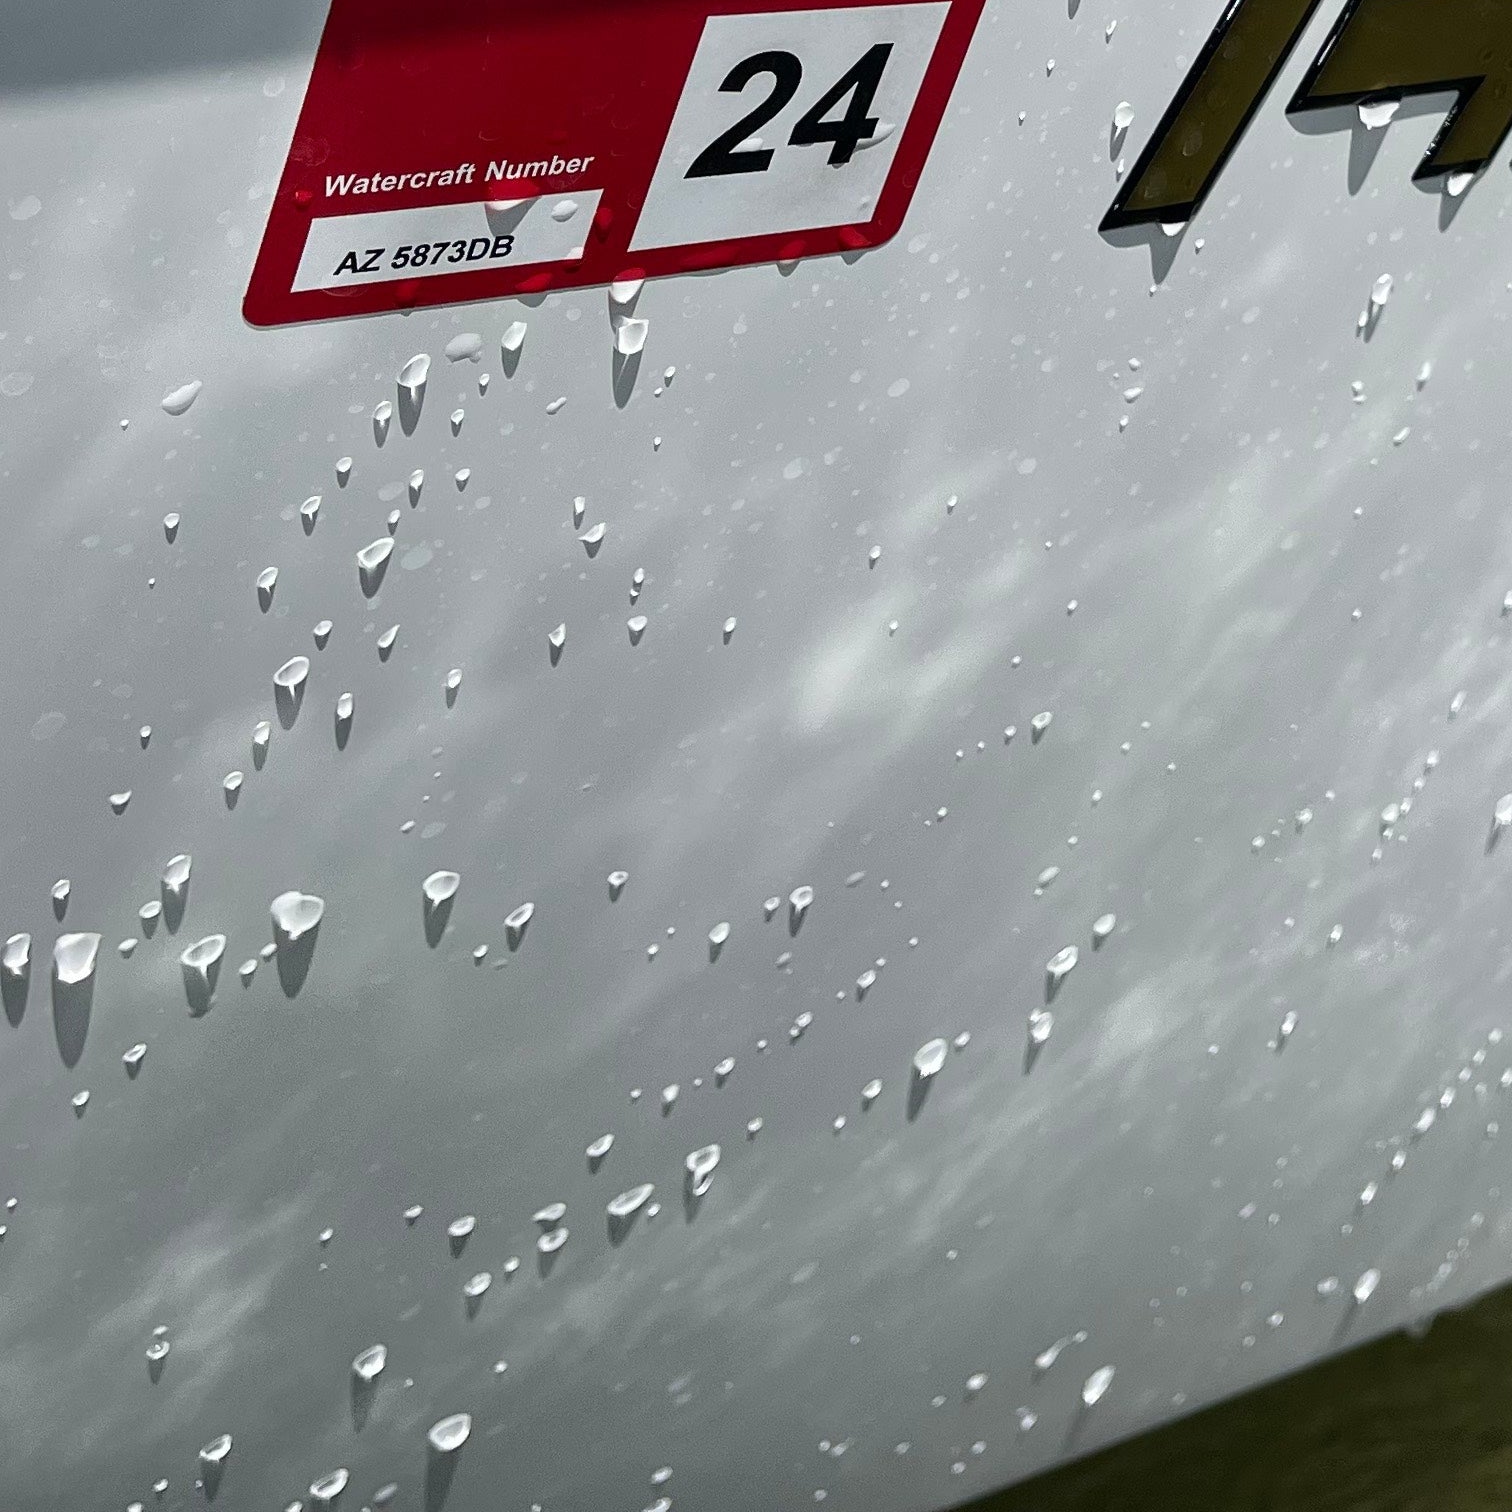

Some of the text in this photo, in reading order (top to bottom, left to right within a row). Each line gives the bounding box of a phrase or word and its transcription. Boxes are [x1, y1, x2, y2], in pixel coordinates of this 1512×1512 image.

[683, 42, 895, 179] 24
[324, 155, 595, 197] Watercraft Number
[333, 234, 515, 276] AZ 5873DB
